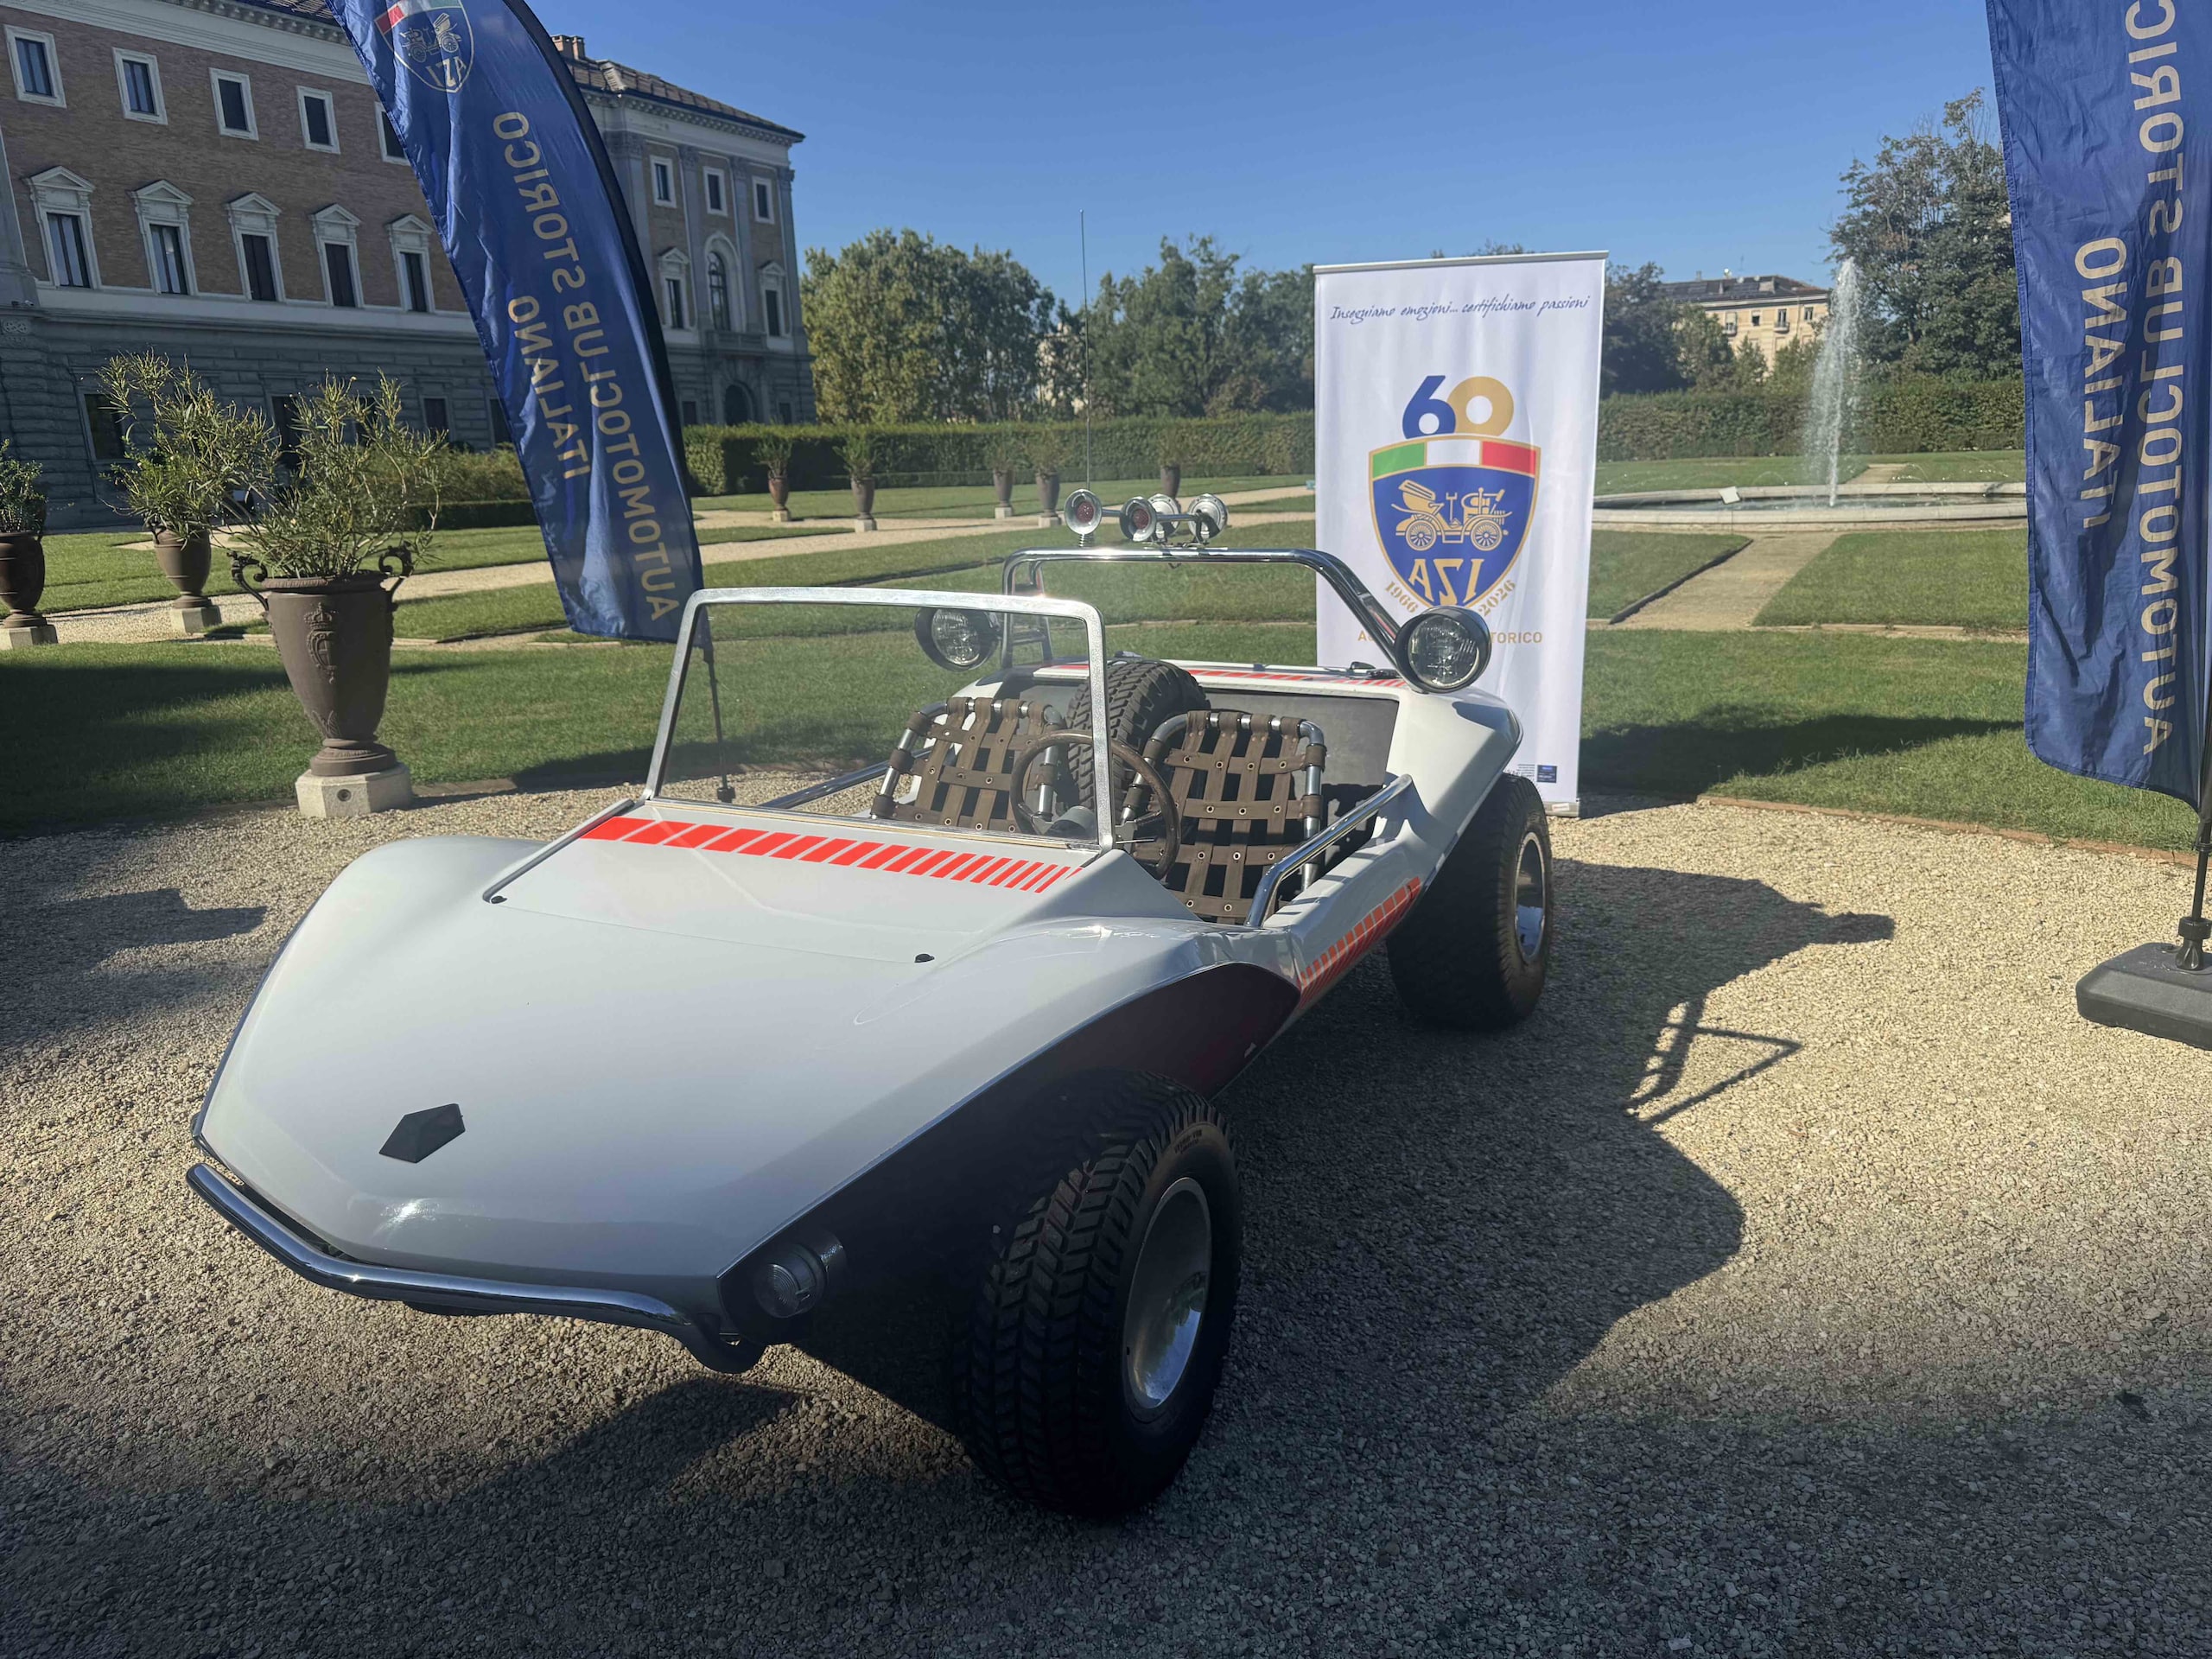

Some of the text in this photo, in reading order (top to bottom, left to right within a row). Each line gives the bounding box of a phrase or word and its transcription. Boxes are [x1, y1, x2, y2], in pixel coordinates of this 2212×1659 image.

[1330, 305, 1395, 325] Inseguiamo
[1461, 294, 1536, 319] certifichiamo
[1536, 295, 1591, 317] passioni
[1402, 375, 1515, 440] 60
[1384, 579, 1516, 617] 1966 2026
[1490, 631, 1543, 644] TORICO
